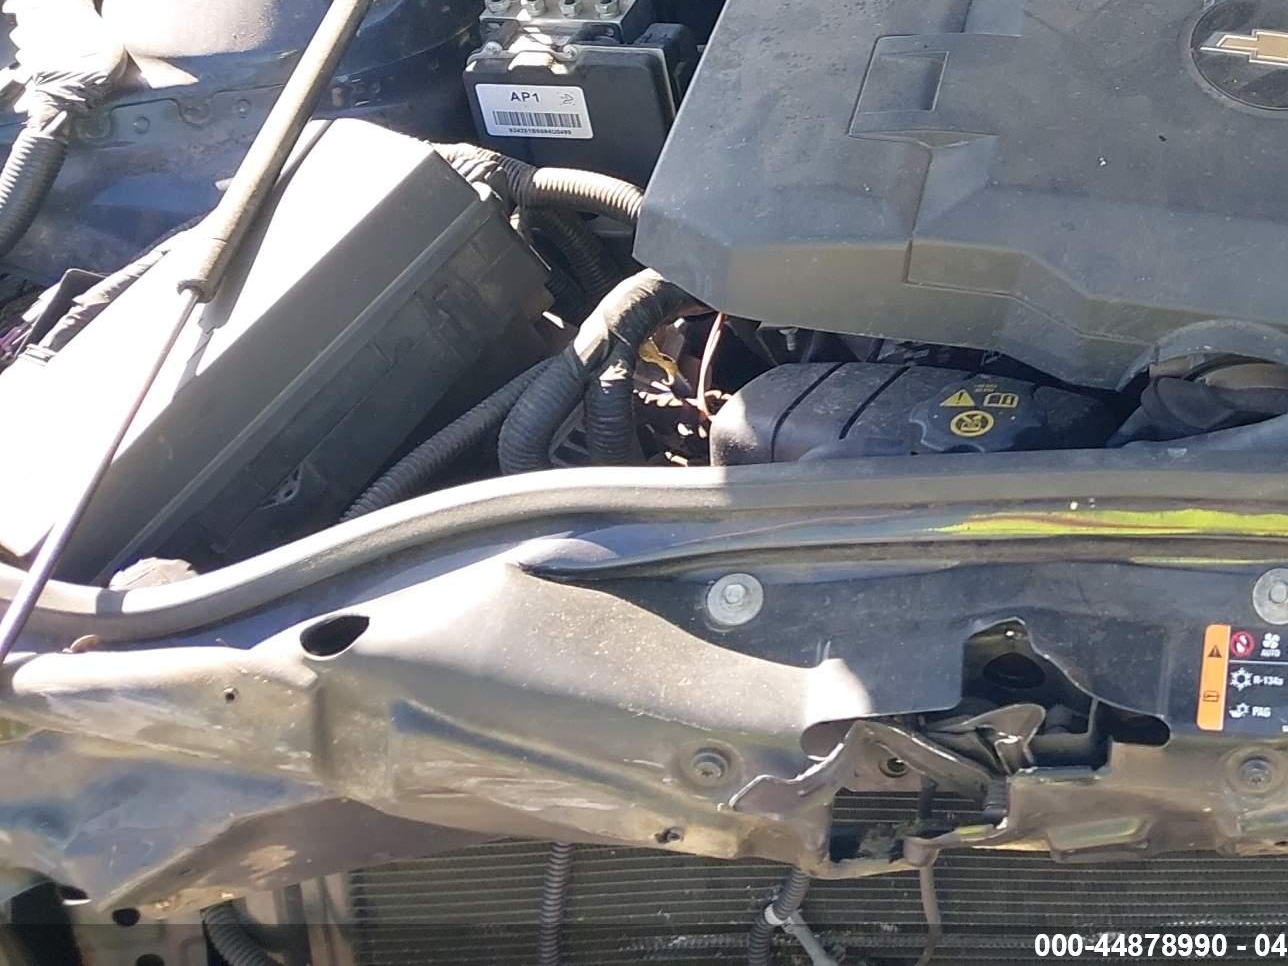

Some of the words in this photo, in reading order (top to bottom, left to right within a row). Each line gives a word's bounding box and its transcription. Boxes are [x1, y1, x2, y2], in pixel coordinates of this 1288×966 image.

[510, 91, 540, 102] AP1
[1260, 649, 1281, 657] AUTO
[1253, 675, 1284, 685] R-134a
[1252, 706, 1271, 717] PAG
